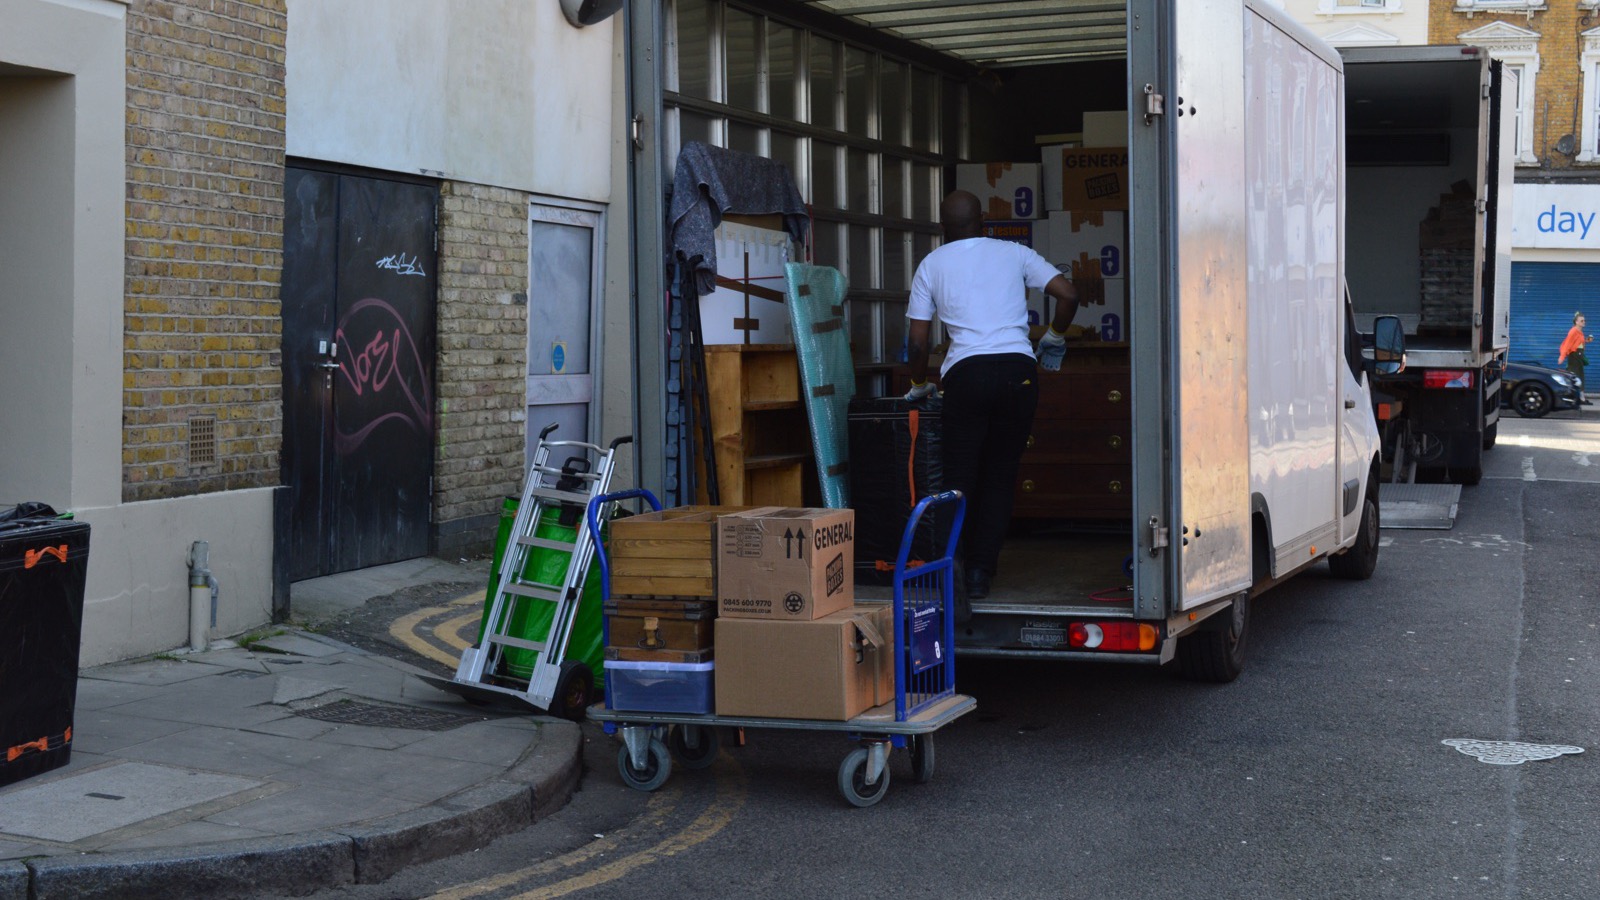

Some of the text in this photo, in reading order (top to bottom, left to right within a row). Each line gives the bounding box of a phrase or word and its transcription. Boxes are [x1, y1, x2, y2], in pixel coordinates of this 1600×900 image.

[983, 226, 1028, 237] safestore
[1537, 204, 1596, 240] day
[814, 521, 852, 550] GENERAL
[723, 598, 740, 606] 0845
[741, 599, 754, 607] 600
